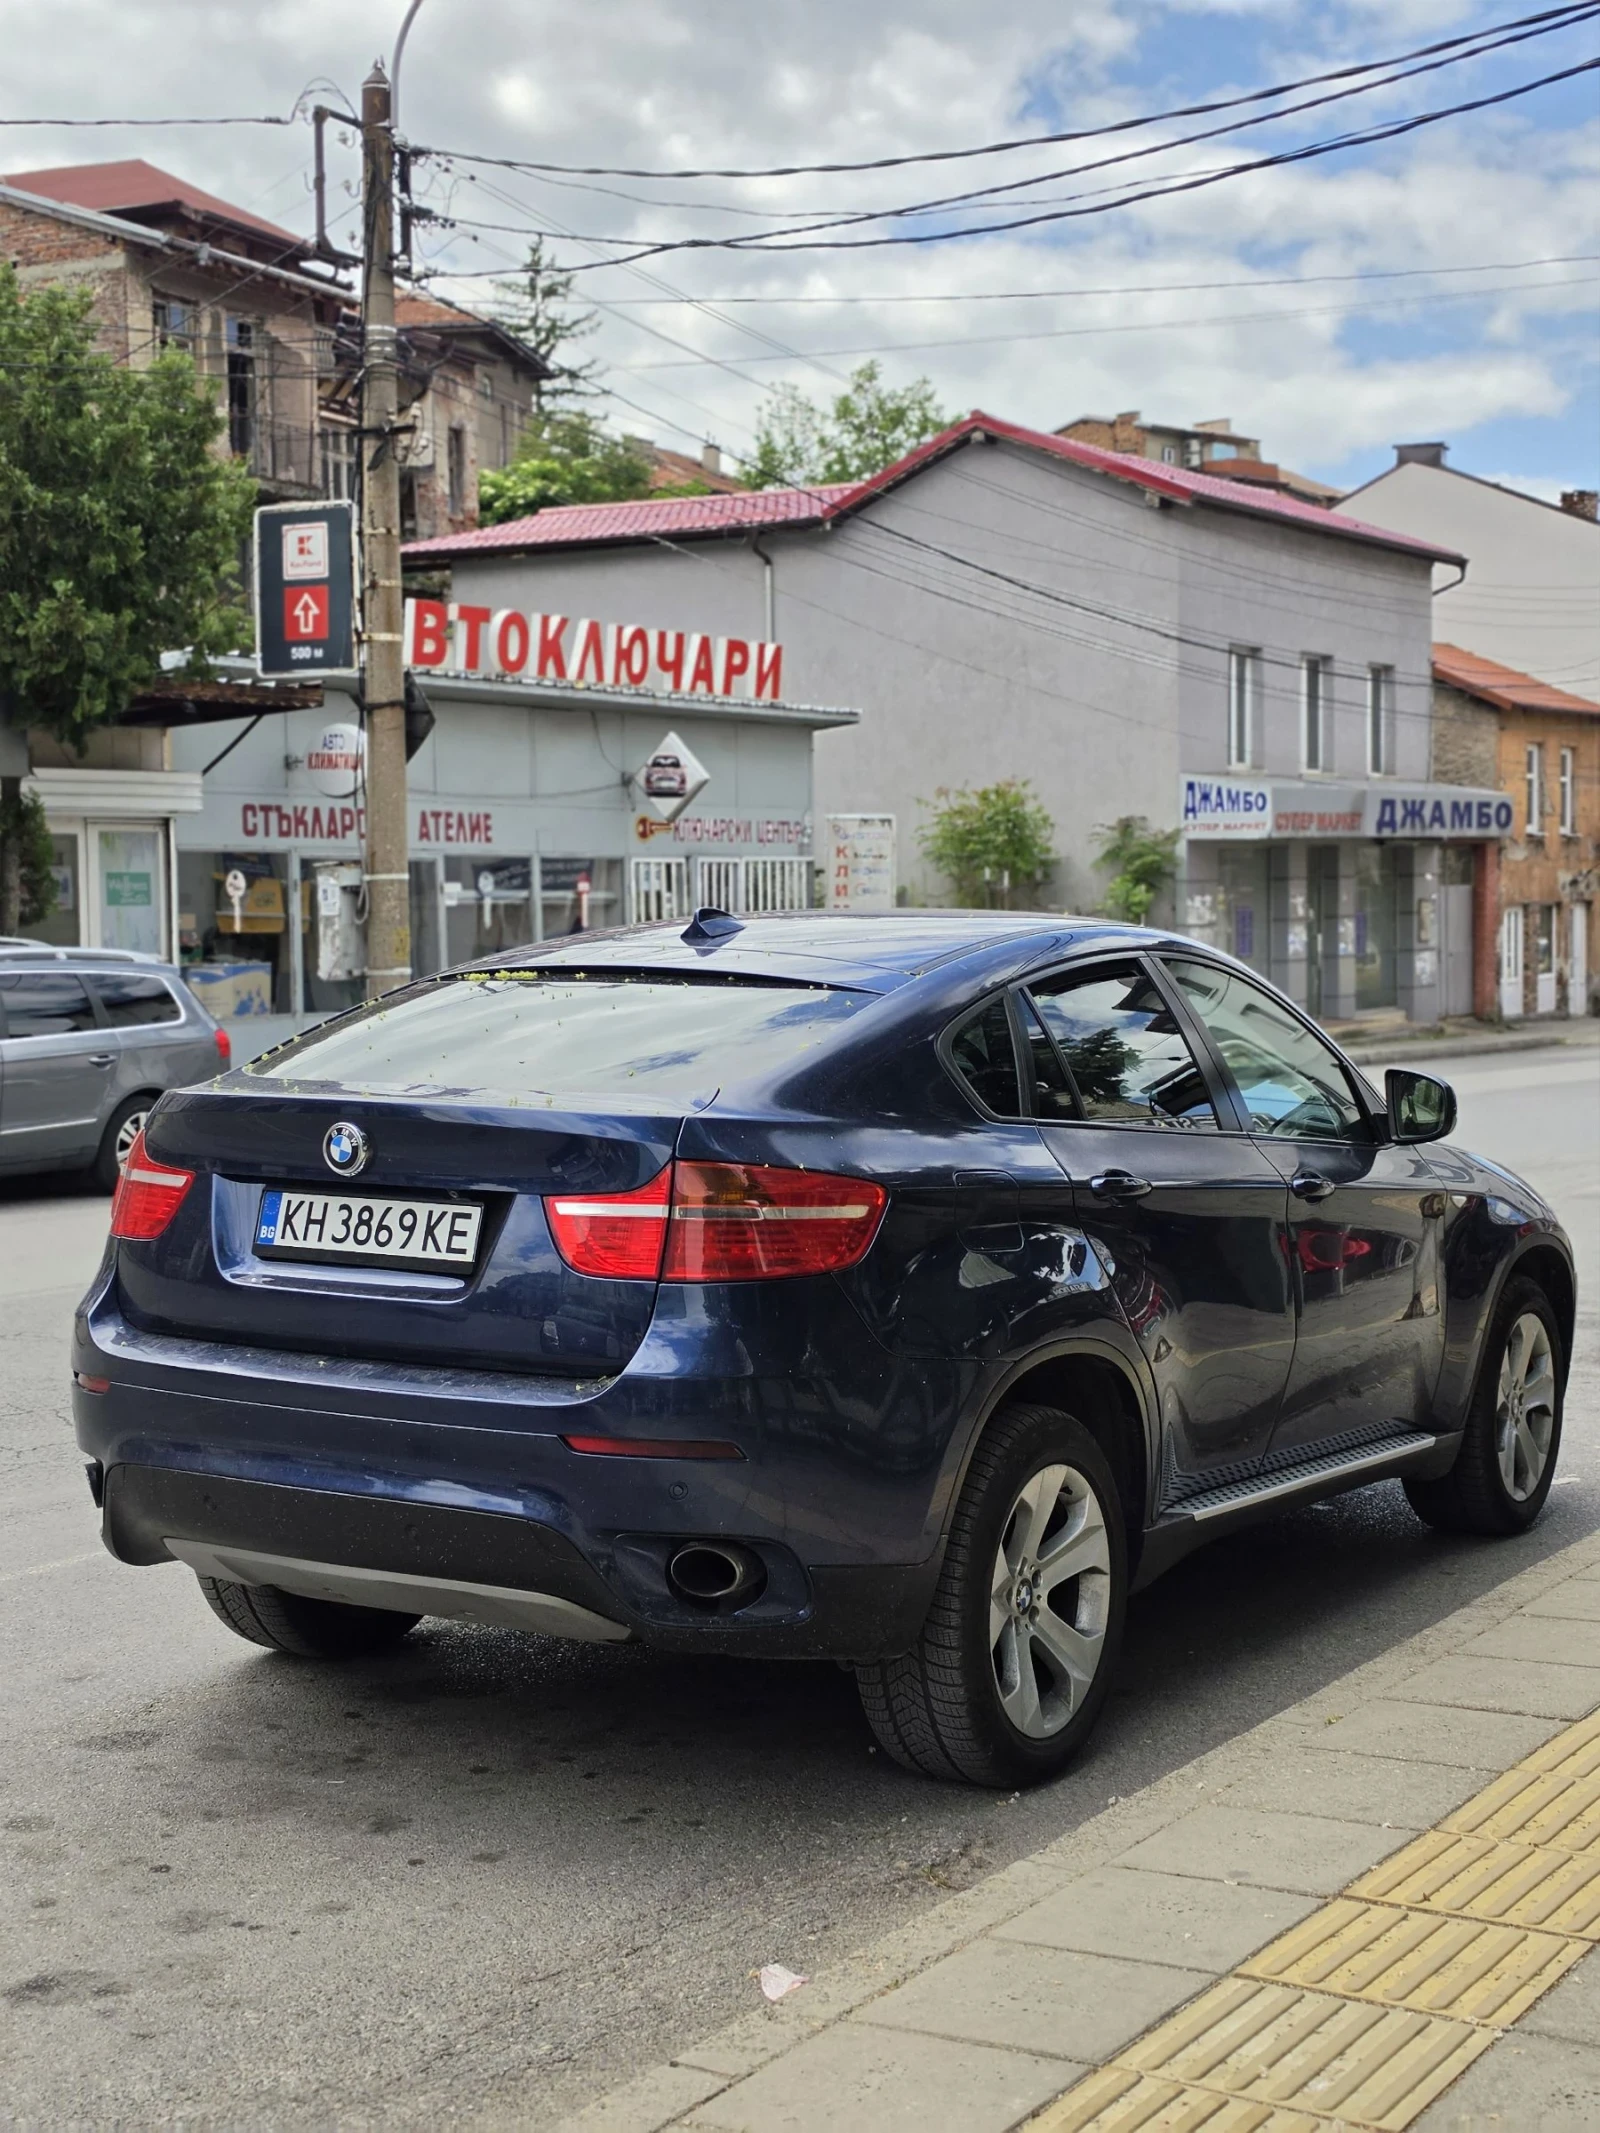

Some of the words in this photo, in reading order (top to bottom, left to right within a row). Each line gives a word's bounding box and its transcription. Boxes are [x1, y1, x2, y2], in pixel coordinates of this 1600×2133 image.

[290, 647, 312, 660] 500
[402, 597, 783, 700] ВТОКЛЮЧАРИ
[322, 733, 346, 750] АВТО
[1184, 781, 1267, 820] ДЖАМБО
[418, 811, 493, 843] АТЕЛИЕ
[1376, 798, 1513, 834] ДЖАМБО
[331, 1128, 359, 1147] BMW
[260, 1226, 275, 1238] BG
